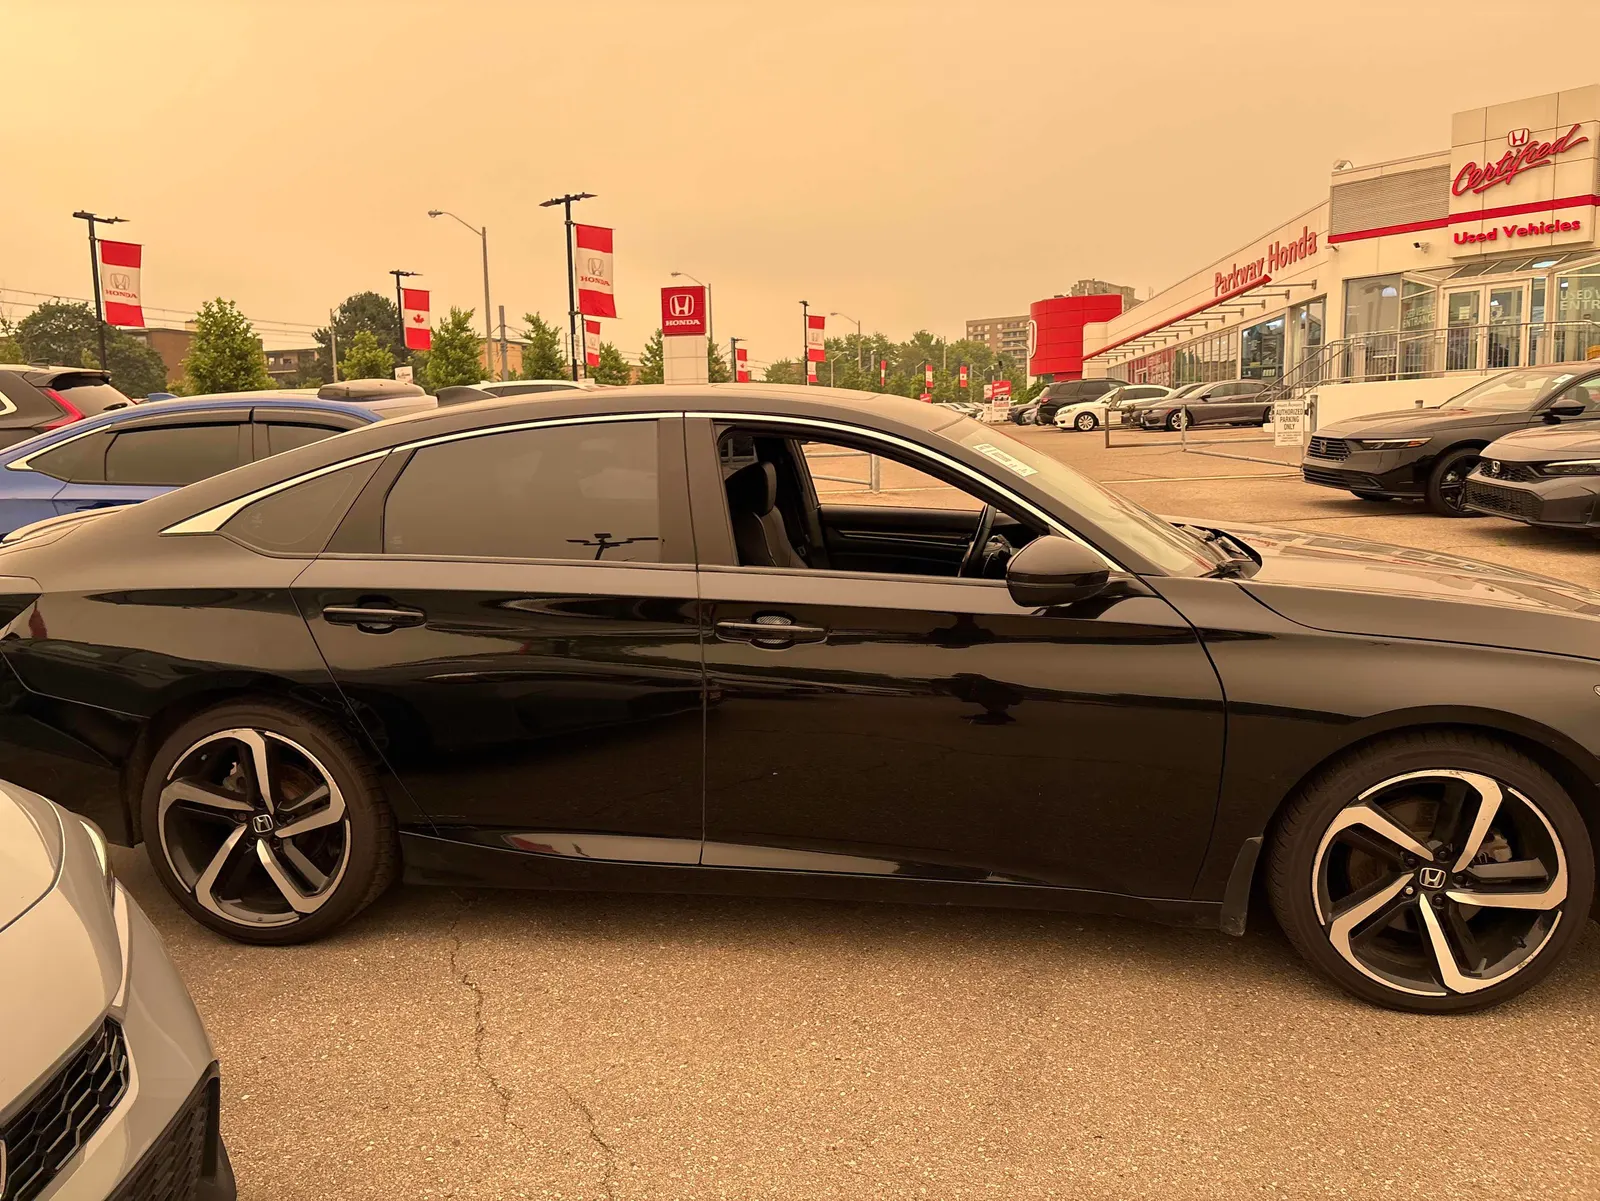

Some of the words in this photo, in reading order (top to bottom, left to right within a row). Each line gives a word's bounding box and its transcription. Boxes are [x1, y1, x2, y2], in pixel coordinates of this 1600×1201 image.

[1452, 124, 1589, 196] Certified
[1454, 228, 1498, 245] Used
[1503, 219, 1581, 238] Vehicles
[1214, 257, 1264, 297] Parkway
[1268, 226, 1317, 273] Honda
[580, 276, 610, 286] HONDA
[105, 289, 138, 298] HONDA
[1560, 289, 1593, 300] USED
[665, 319, 701, 327] HONDA
